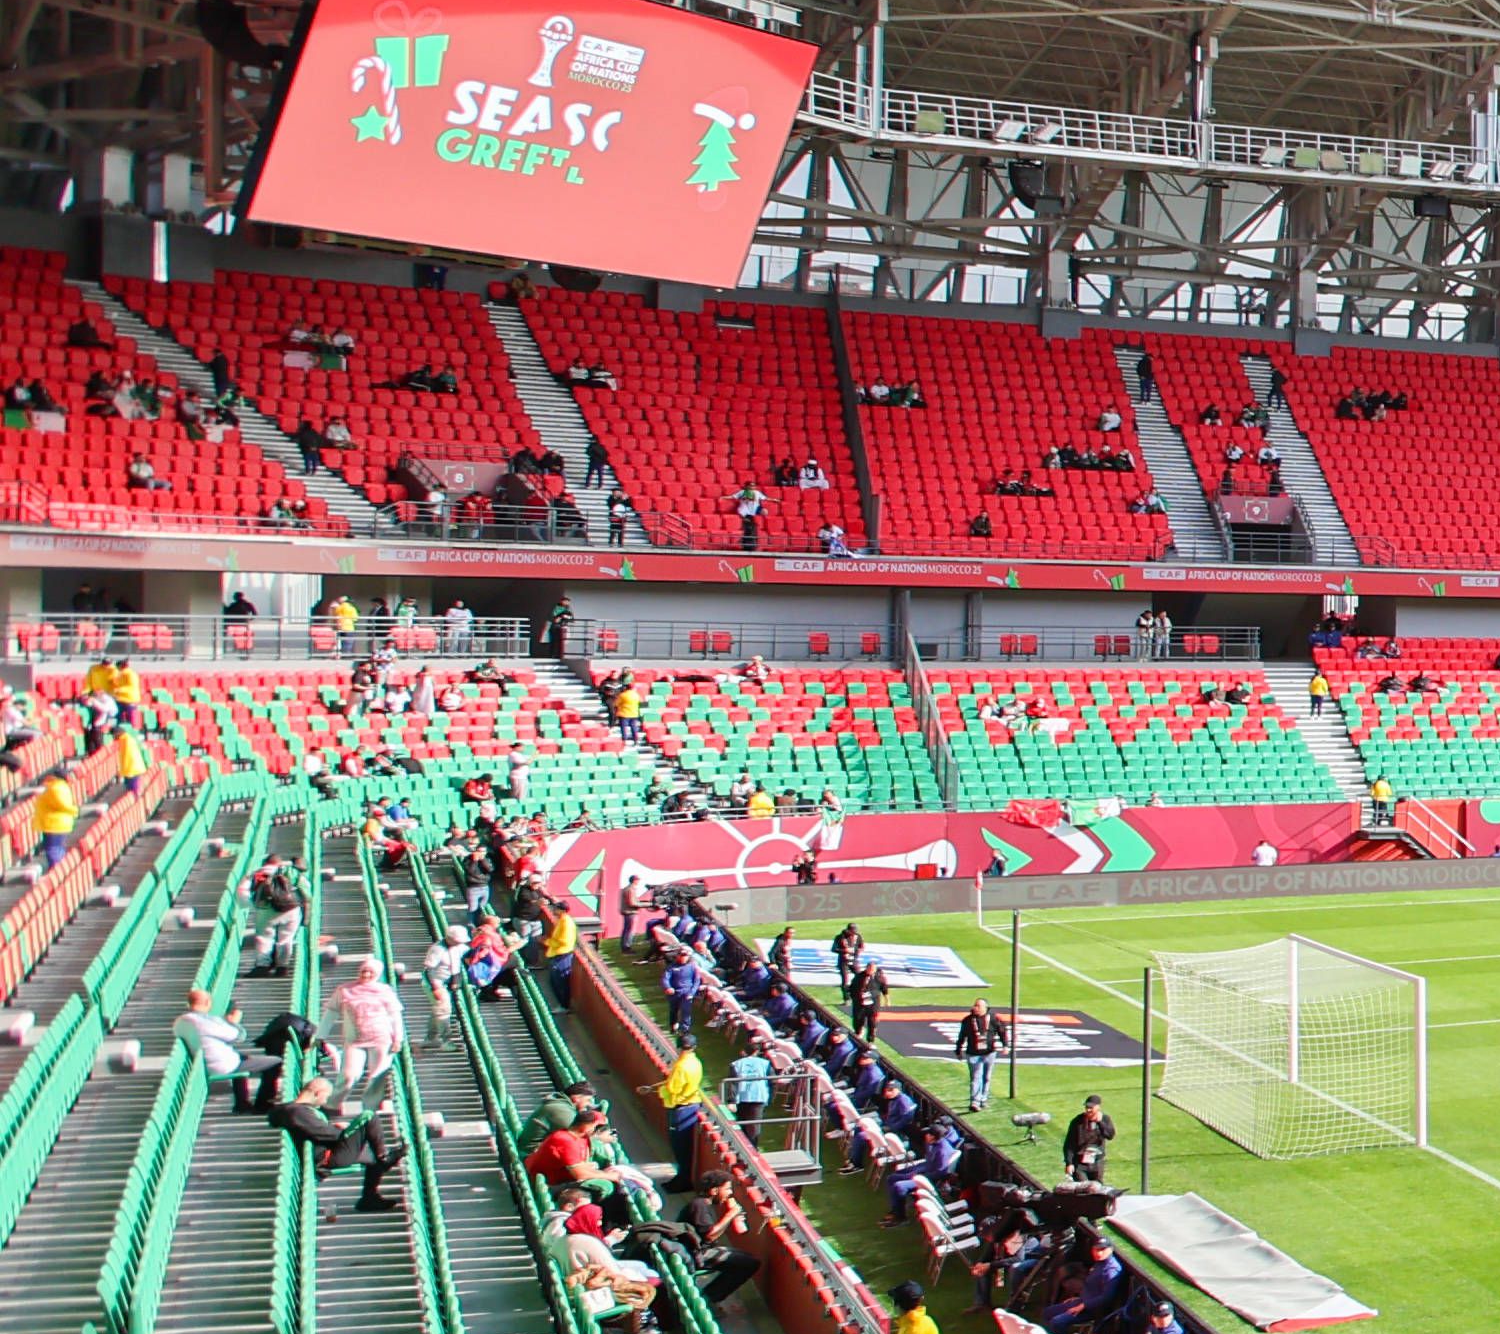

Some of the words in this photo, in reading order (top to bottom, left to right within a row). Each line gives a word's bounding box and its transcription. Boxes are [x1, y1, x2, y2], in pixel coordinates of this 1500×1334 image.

[582, 40, 614, 54] CAF
[574, 53, 615, 70] AFRICA
[616, 58, 640, 74] CUP
[571, 62, 588, 75] OF
[588, 64, 636, 84] NATIONS
[568, 72, 620, 90] MOROCCO
[620, 83, 632, 93] 25
[455, 474, 464, 483] 8
[396, 551, 422, 560] CAF
[429, 550, 460, 562] AFRICA
[462, 552, 480, 562] CUP
[482, 553, 494, 563] OF
[495, 553, 535, 564] NATIONS
[535, 555, 582, 565] MOROCCO
[584, 556, 594, 566] 25
[792, 562, 820, 570] CAF
[827, 562, 858, 572] AFRICA
[859, 563, 880, 573] CUP
[881, 563, 890, 573] OF
[890, 564, 927, 574] NATIONS
[927, 565, 971, 575] MOROCCO
[972, 565, 982, 574] 25
[1159, 571, 1181, 579] CAF
[1188, 570, 1216, 580] AFRICA
[1217, 571, 1231, 581] CUP
[1233, 572, 1243, 581] OF
[1243, 572, 1275, 582] NATIONS
[1275, 574, 1312, 583] MOROCCO
[1313, 574, 1322, 583] 25
[1475, 578, 1496, 586] CAF
[1027, 881, 1102, 901] CAF
[1129, 875, 1216, 899] AFRICA
[1222, 872, 1270, 894] CUP
[1274, 870, 1307, 891] OF
[1312, 865, 1408, 889] NATIONS
[817, 893, 842, 914] 25
